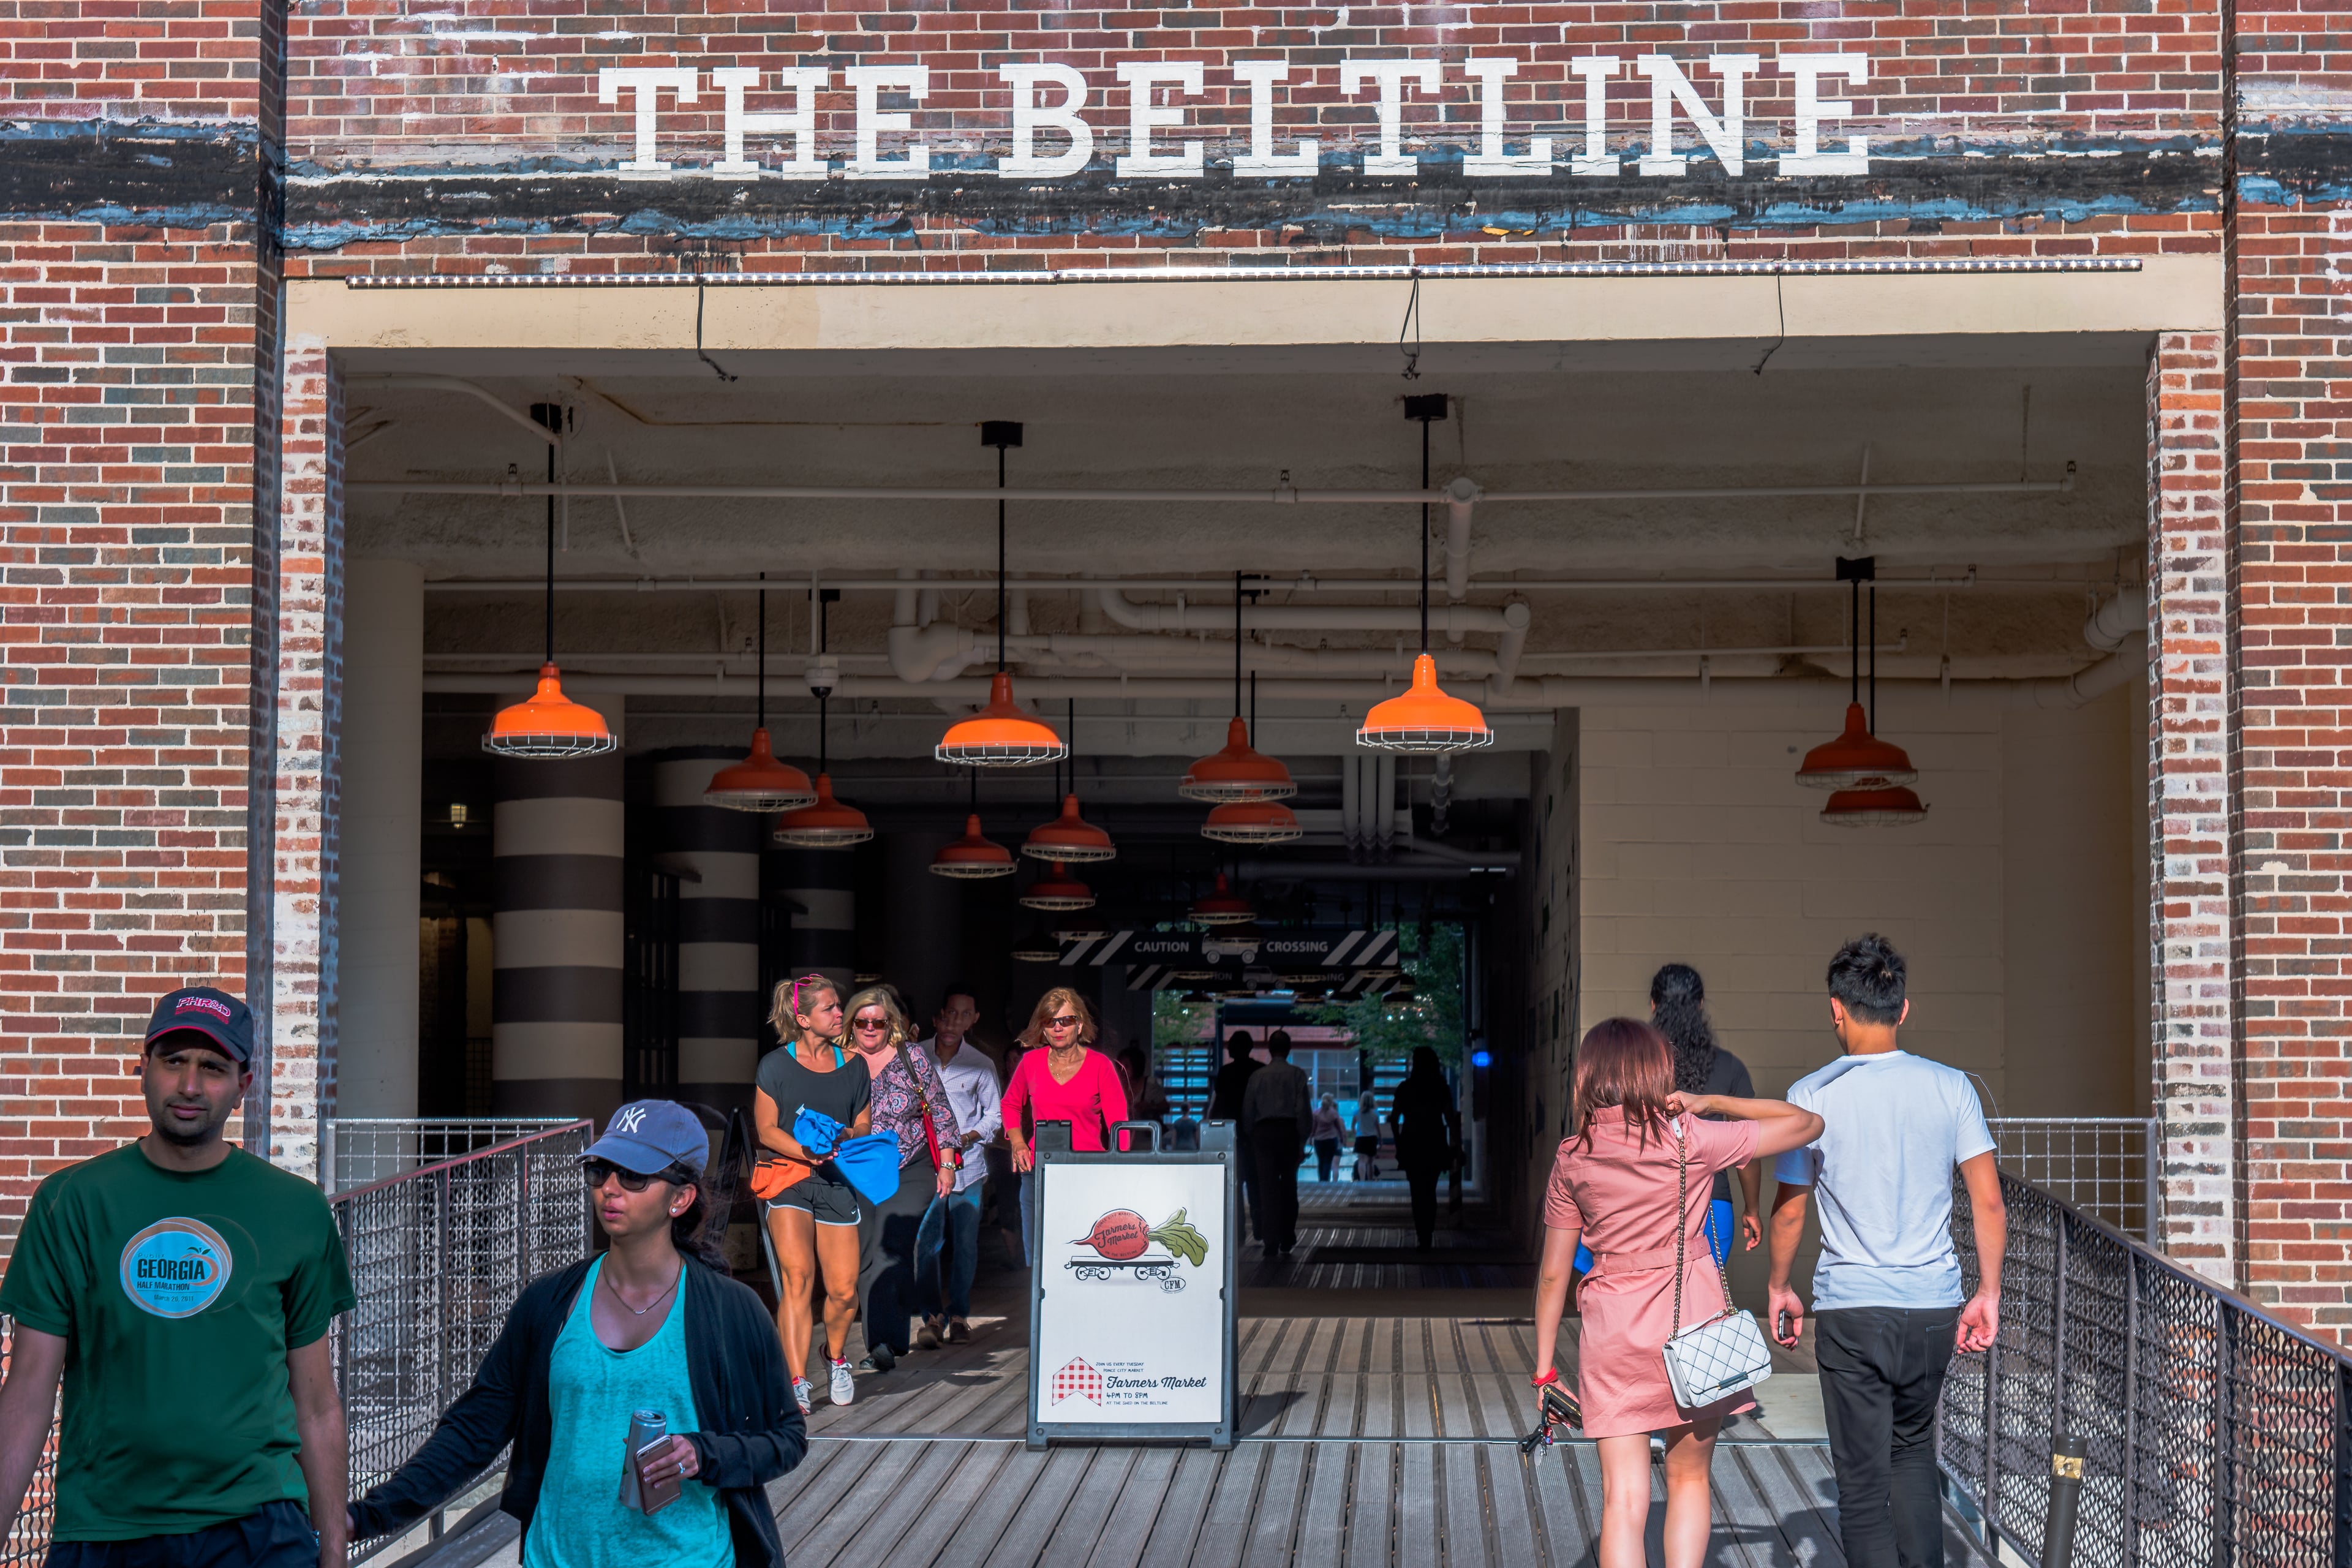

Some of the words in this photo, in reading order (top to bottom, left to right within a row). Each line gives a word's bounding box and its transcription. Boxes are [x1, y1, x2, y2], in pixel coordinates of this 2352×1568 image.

[598, 65, 929, 181] THE
[998, 53, 1869, 179] BELTLINE
[1134, 941, 1189, 952] CAUTION
[1266, 941, 1329, 952] CROSSING
[616, 1107, 646, 1133] NY
[1094, 1223, 1137, 1249] Farmers
[1107, 1231, 1138, 1246] Market
[137, 1259, 205, 1281] GEORGIA
[154, 1281, 190, 1291] MARATHON
[1164, 1280, 1181, 1290] CFM
[1106, 1376, 1158, 1389] Farmers
[1161, 1376, 1207, 1390] Market
